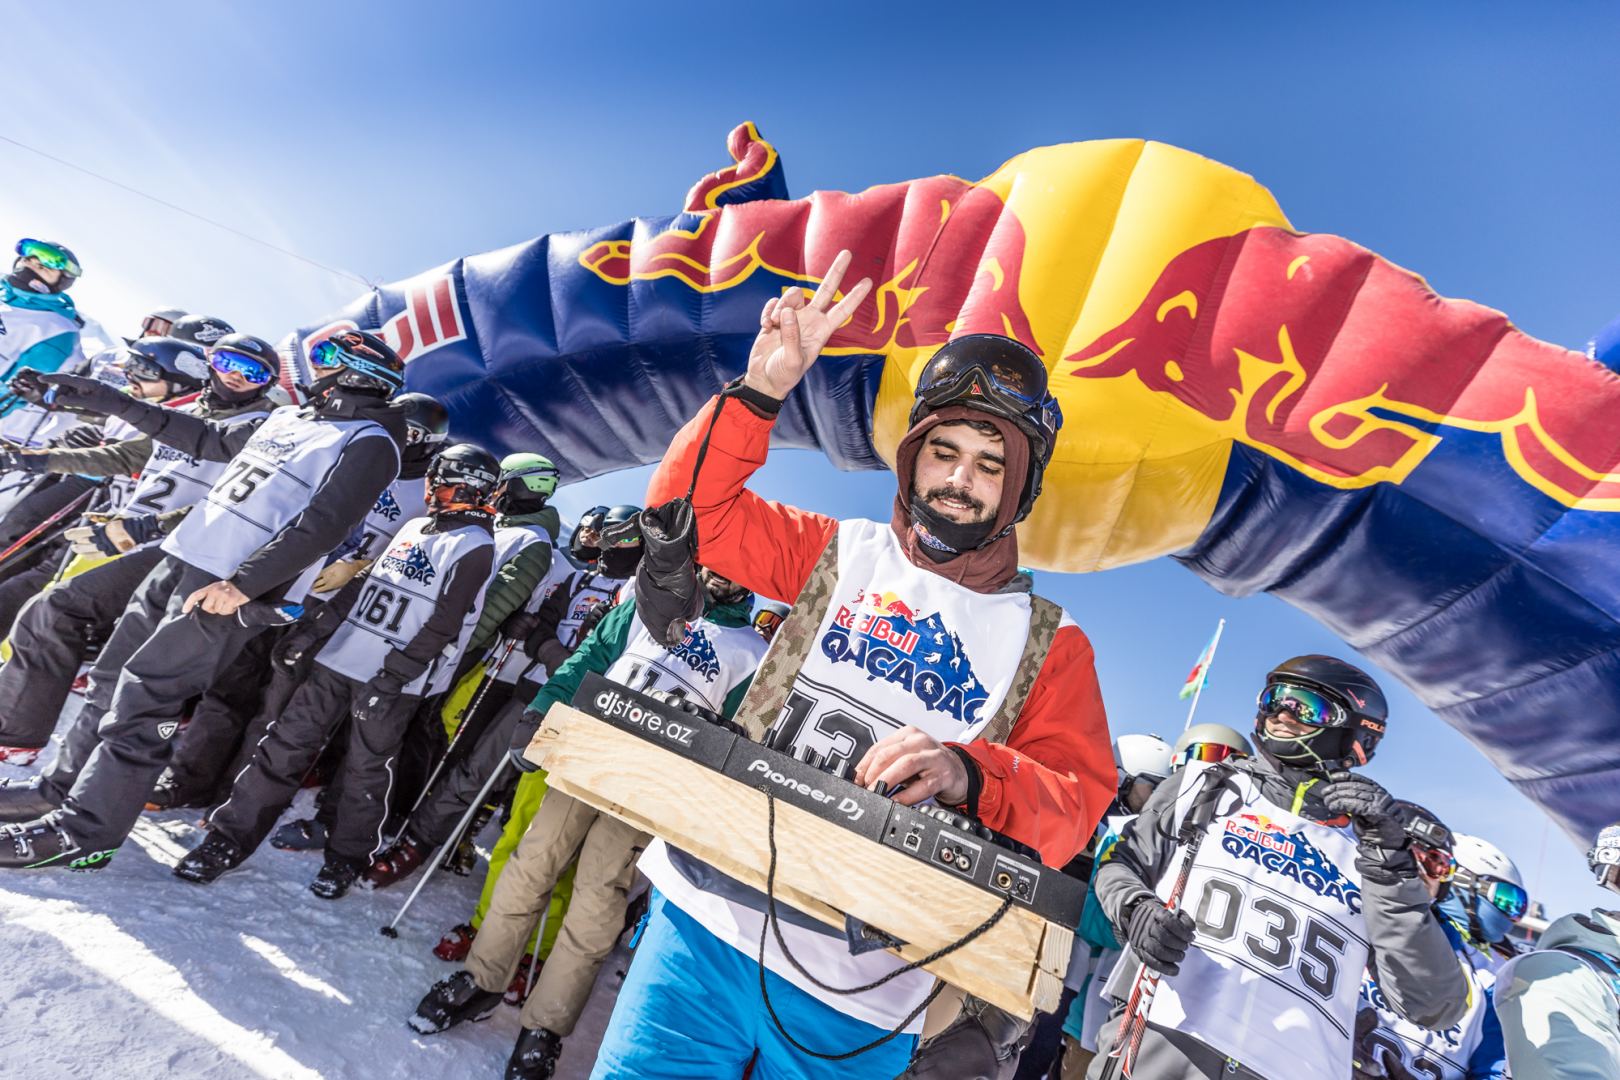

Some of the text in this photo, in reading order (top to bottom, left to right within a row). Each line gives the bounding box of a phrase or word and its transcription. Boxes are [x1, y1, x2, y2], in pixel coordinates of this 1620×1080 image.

[355, 585, 412, 633] 061
[834, 604, 920, 655] Red Bull
[596, 691, 693, 745] djstore.az
[747, 759, 839, 805] Pioneer
[1226, 820, 1296, 858] Red Bull
[1195, 876, 1349, 1001] 035
